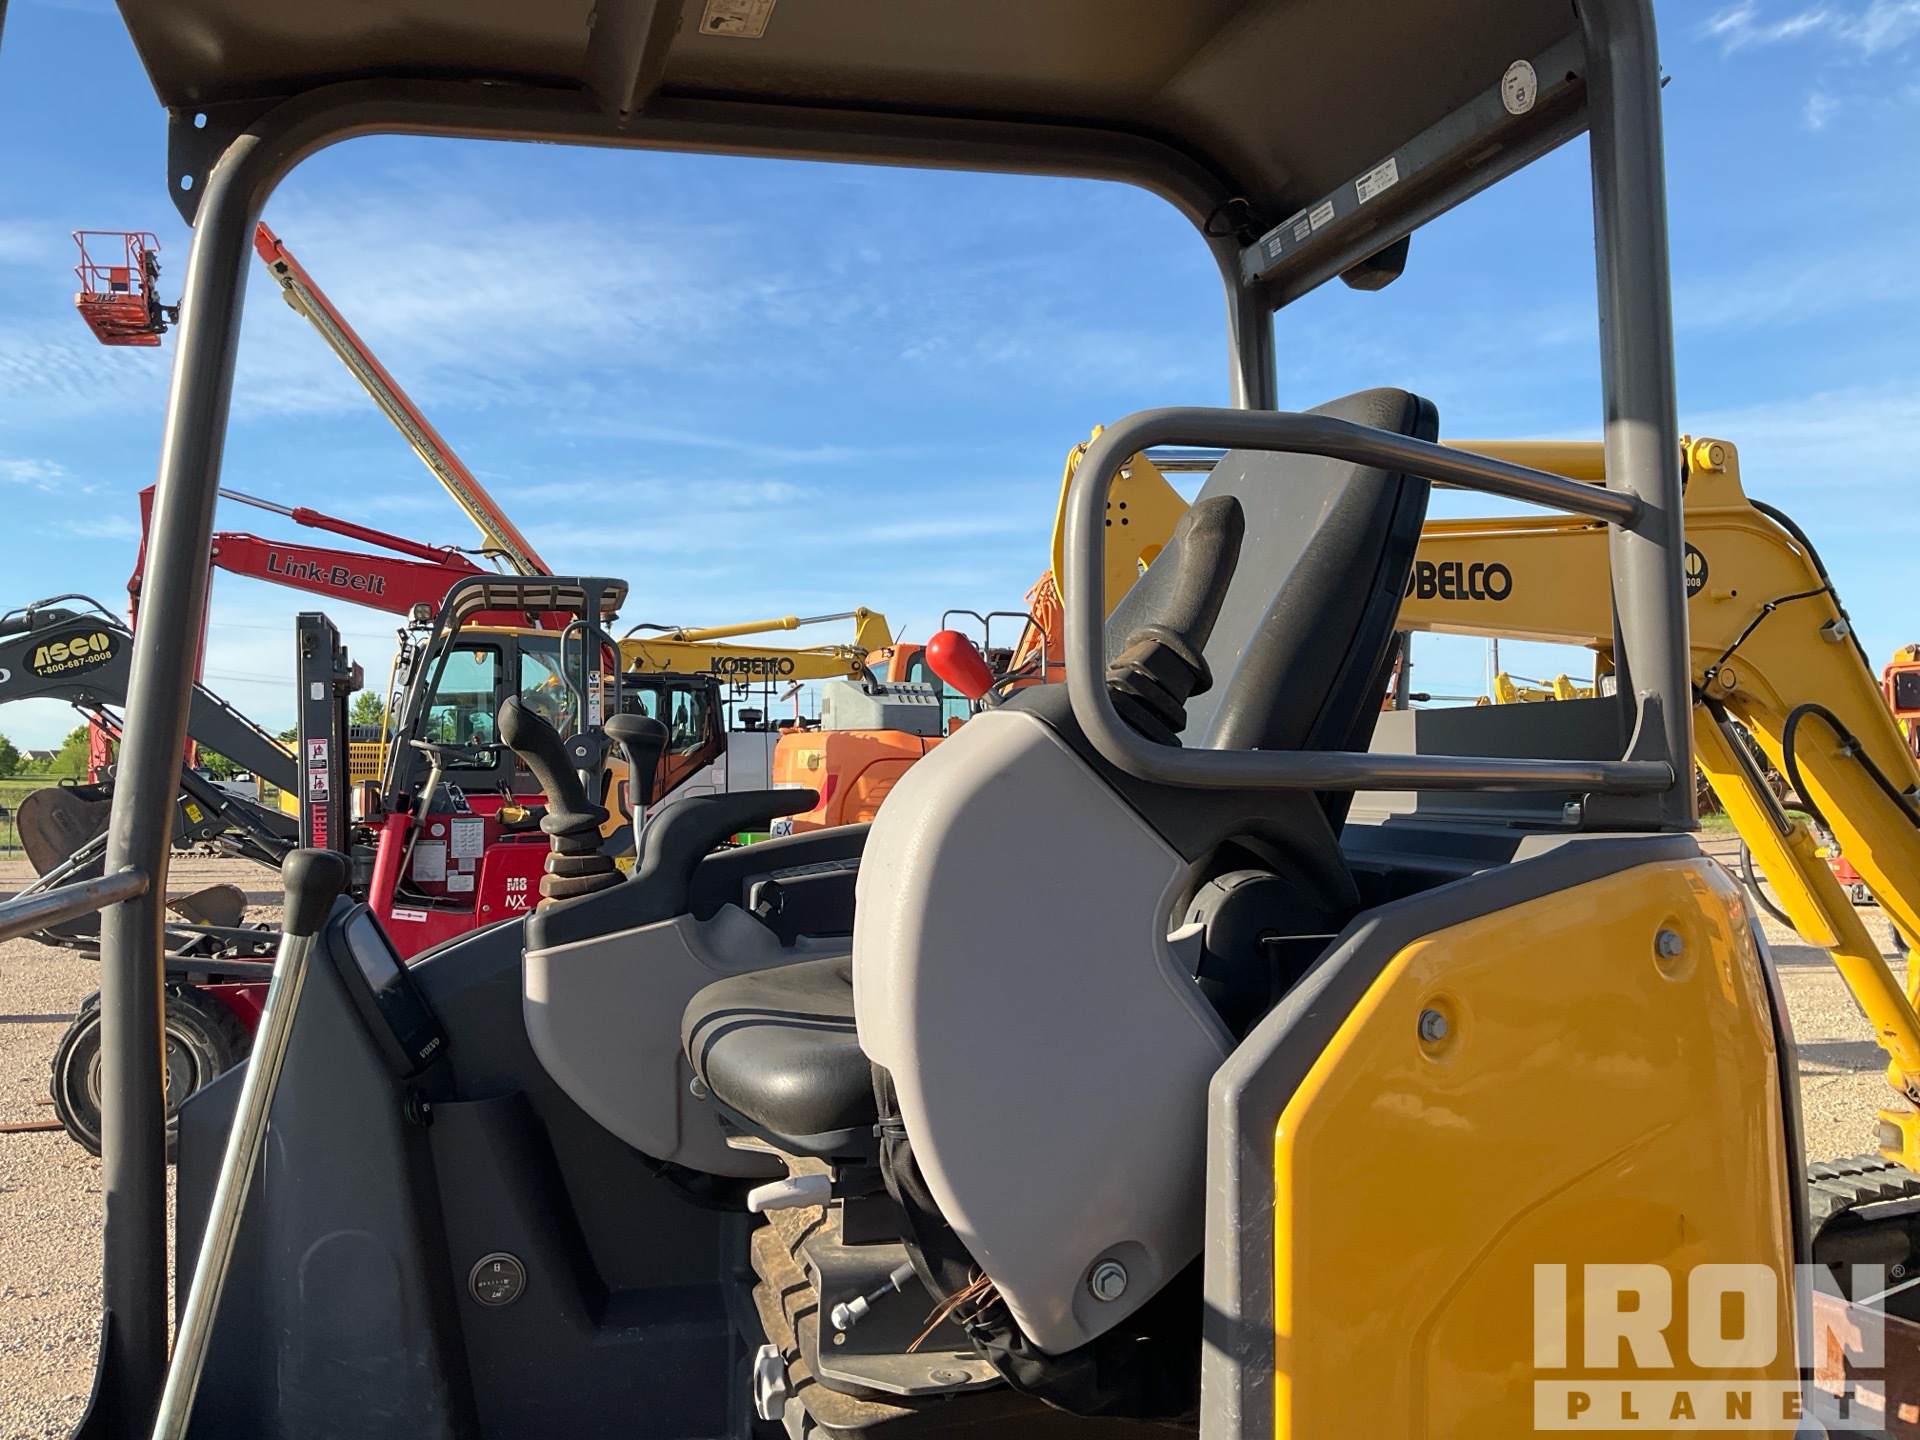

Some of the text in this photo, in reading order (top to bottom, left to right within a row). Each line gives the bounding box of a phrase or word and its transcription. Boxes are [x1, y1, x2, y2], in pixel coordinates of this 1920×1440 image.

[266, 552, 386, 596] Link-Belt
[33, 632, 110, 668] ASCO
[37, 651, 112, 676] 1-800-687-0008
[710, 656, 795, 675] KOBELCO
[506, 877, 528, 891] M8
[505, 894, 527, 910] NX
[419, 1037, 440, 1059] VOLVO
